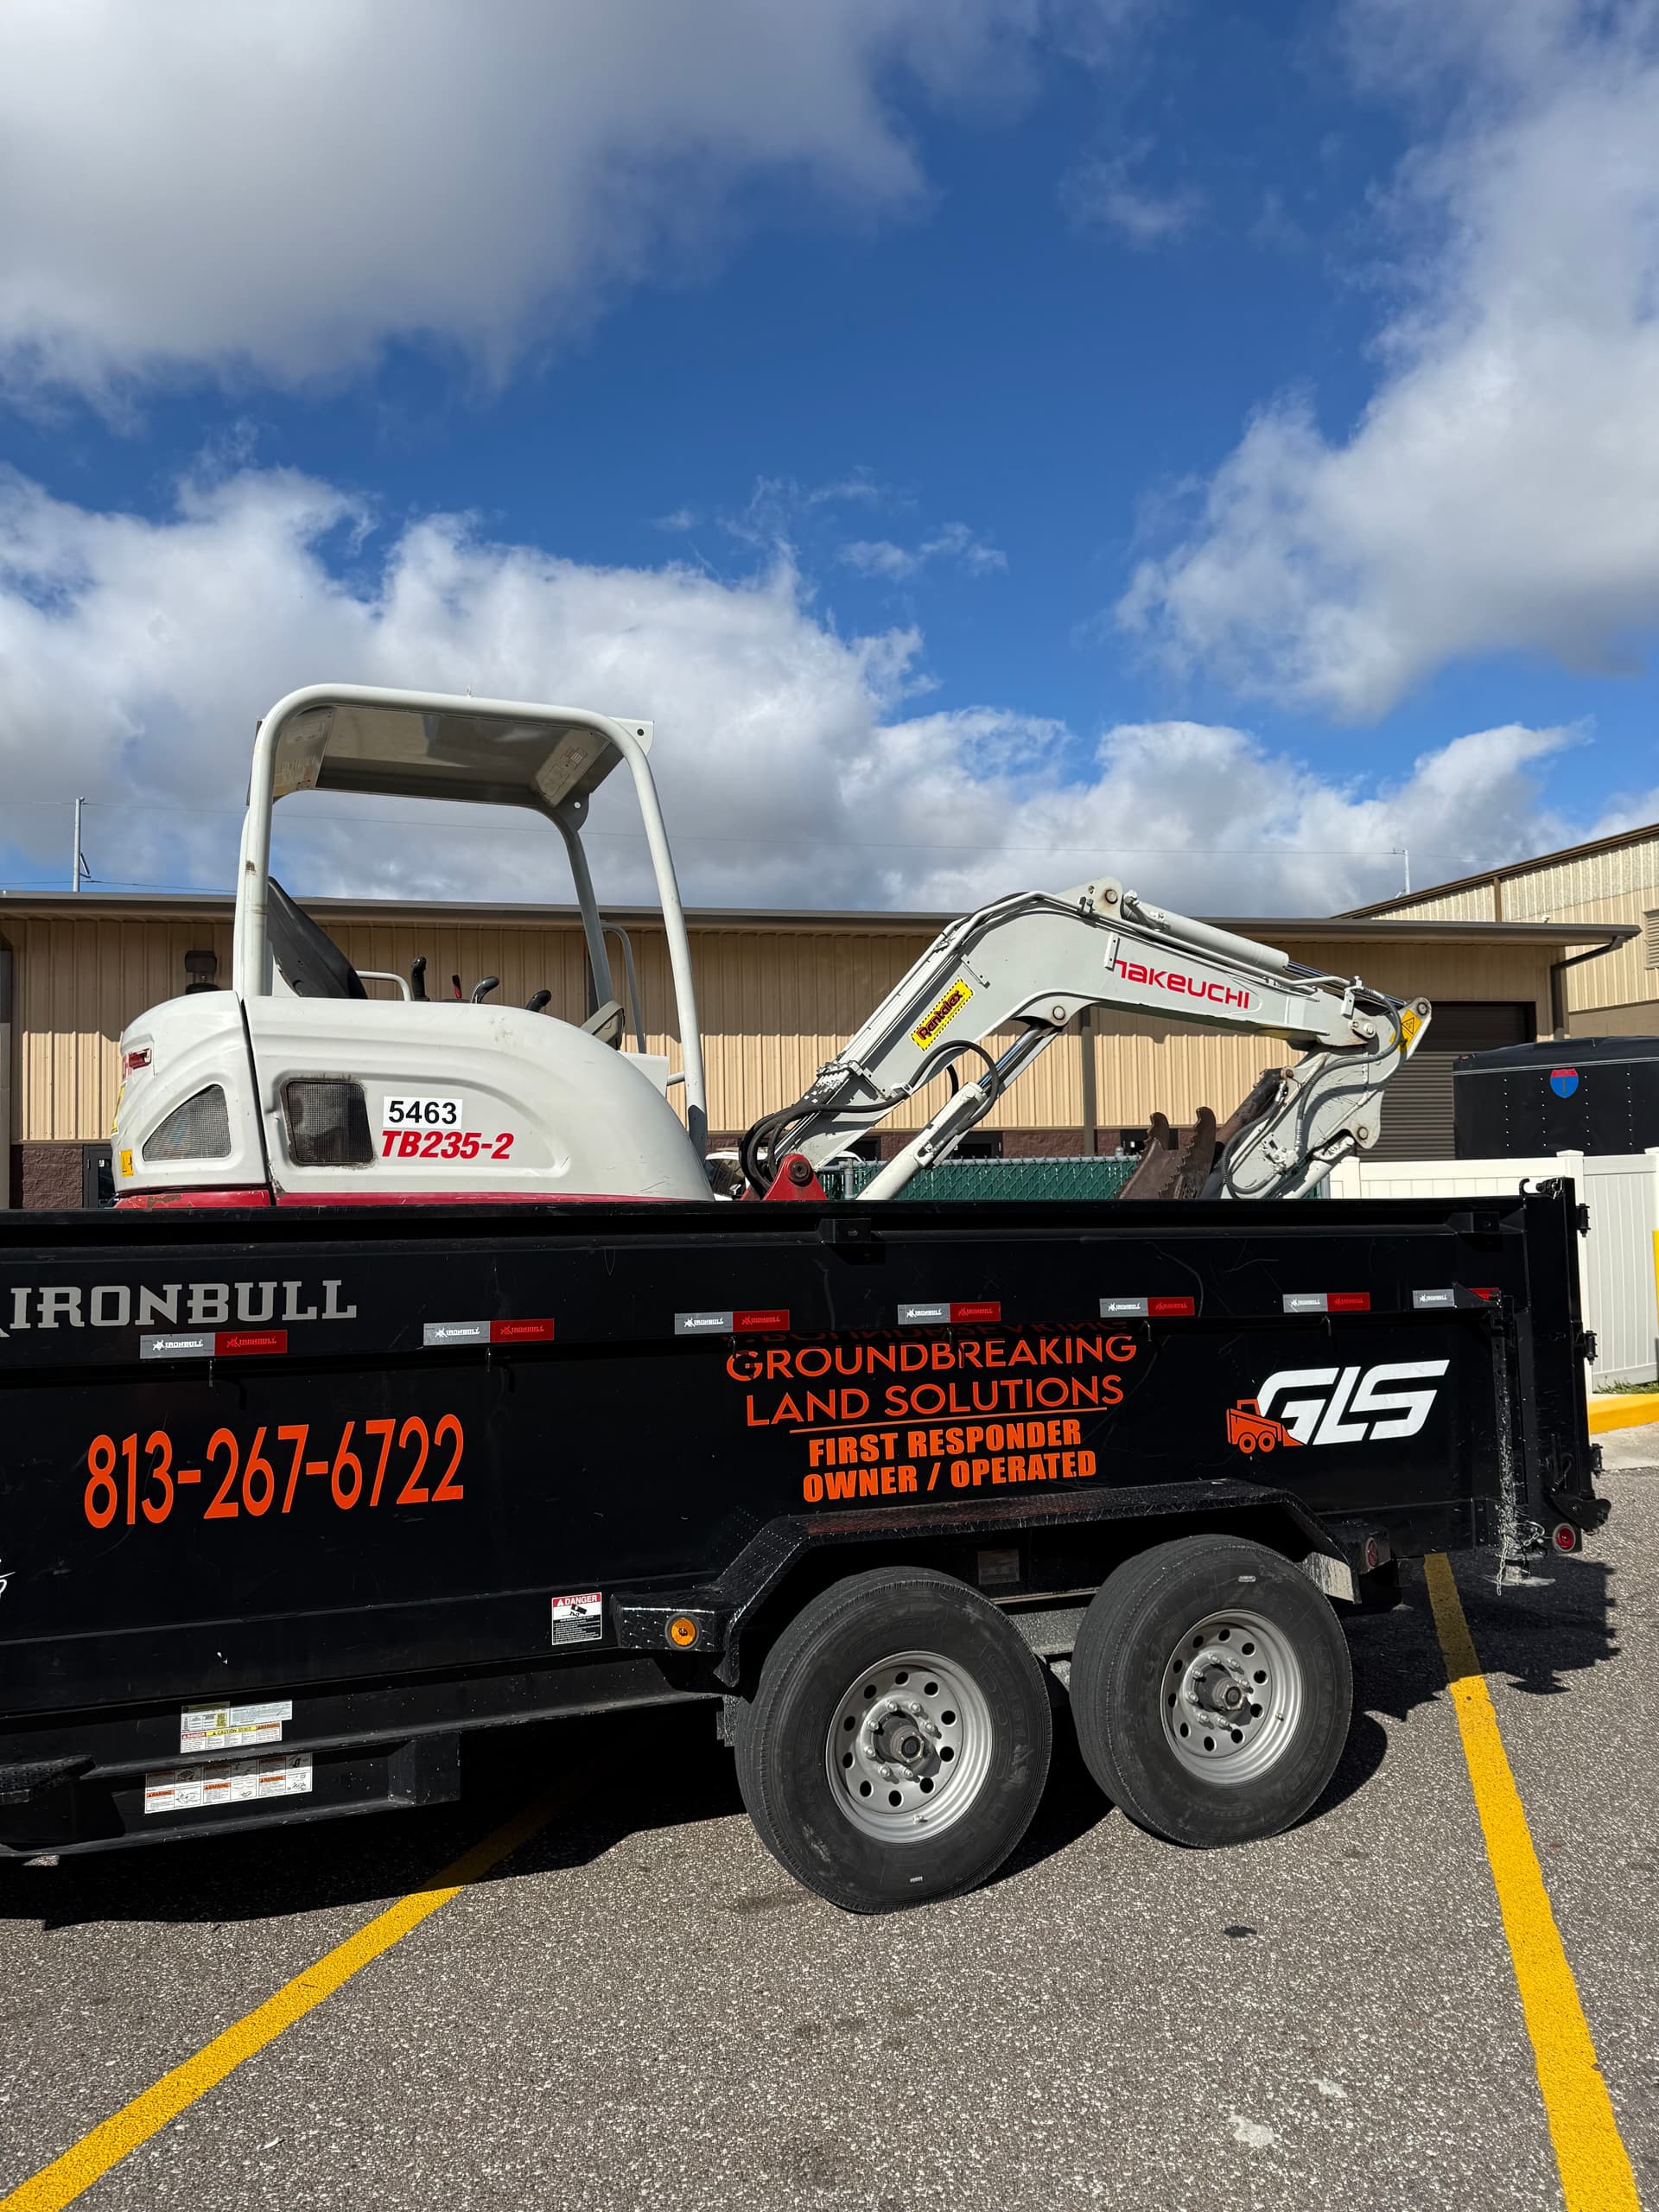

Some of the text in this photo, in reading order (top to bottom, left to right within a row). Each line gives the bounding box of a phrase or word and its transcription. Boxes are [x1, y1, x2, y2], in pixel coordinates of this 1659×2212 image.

[916, 990, 963, 1040] Rentalex
[388, 1100, 457, 1125] 5463
[382, 1130, 515, 1160] TB235-2
[10, 1280, 357, 1330] IRONBULL
[726, 1335, 1137, 1382] GROUNDBREAKING
[747, 1375, 1124, 1427] LAND SOLUTIONS
[1256, 1359, 1451, 1446] GLS
[809, 1419, 1081, 1467] FIRST RESPONDER
[84, 1414, 464, 1529] 813-267-6722
[803, 1450, 1096, 1503] OWNER / OPERATED
[564, 1595, 598, 1605] DANGER
